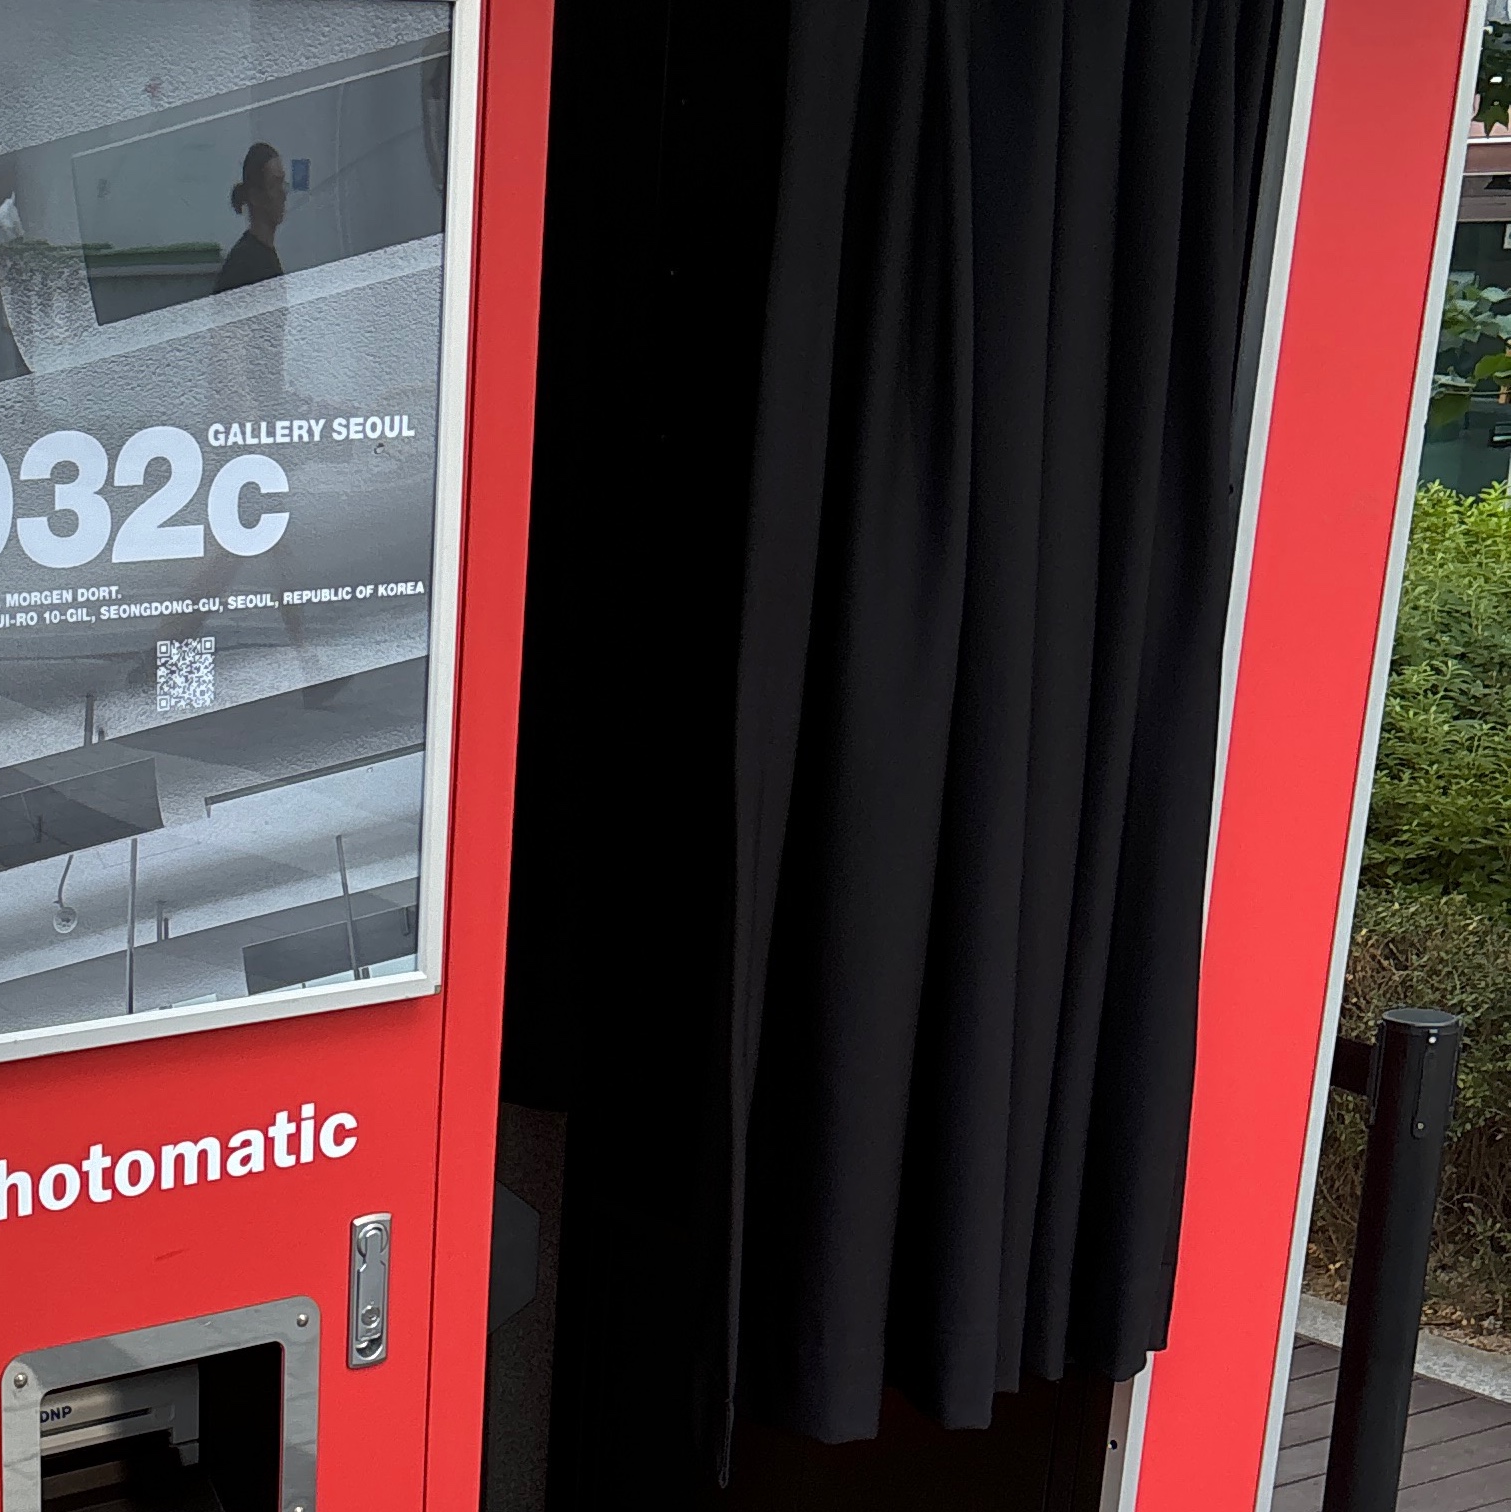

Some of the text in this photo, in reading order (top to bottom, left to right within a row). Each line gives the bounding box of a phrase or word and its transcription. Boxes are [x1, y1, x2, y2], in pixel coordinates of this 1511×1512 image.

[208, 415, 415, 447] GALLERY SEOUL
[5, 589, 73, 607] MORGEN
[77, 586, 122, 603] DORT.
[43, 603, 96, 626] 10-GIL,
[100, 595, 223, 619] SEONGDONG-GU,
[228, 593, 279, 611] SEOUL,
[283, 588, 351, 606] REPUBLIC
[356, 585, 373, 599] OF
[378, 582, 424, 597] KOREA
[41, 1406, 72, 1423] DNP
